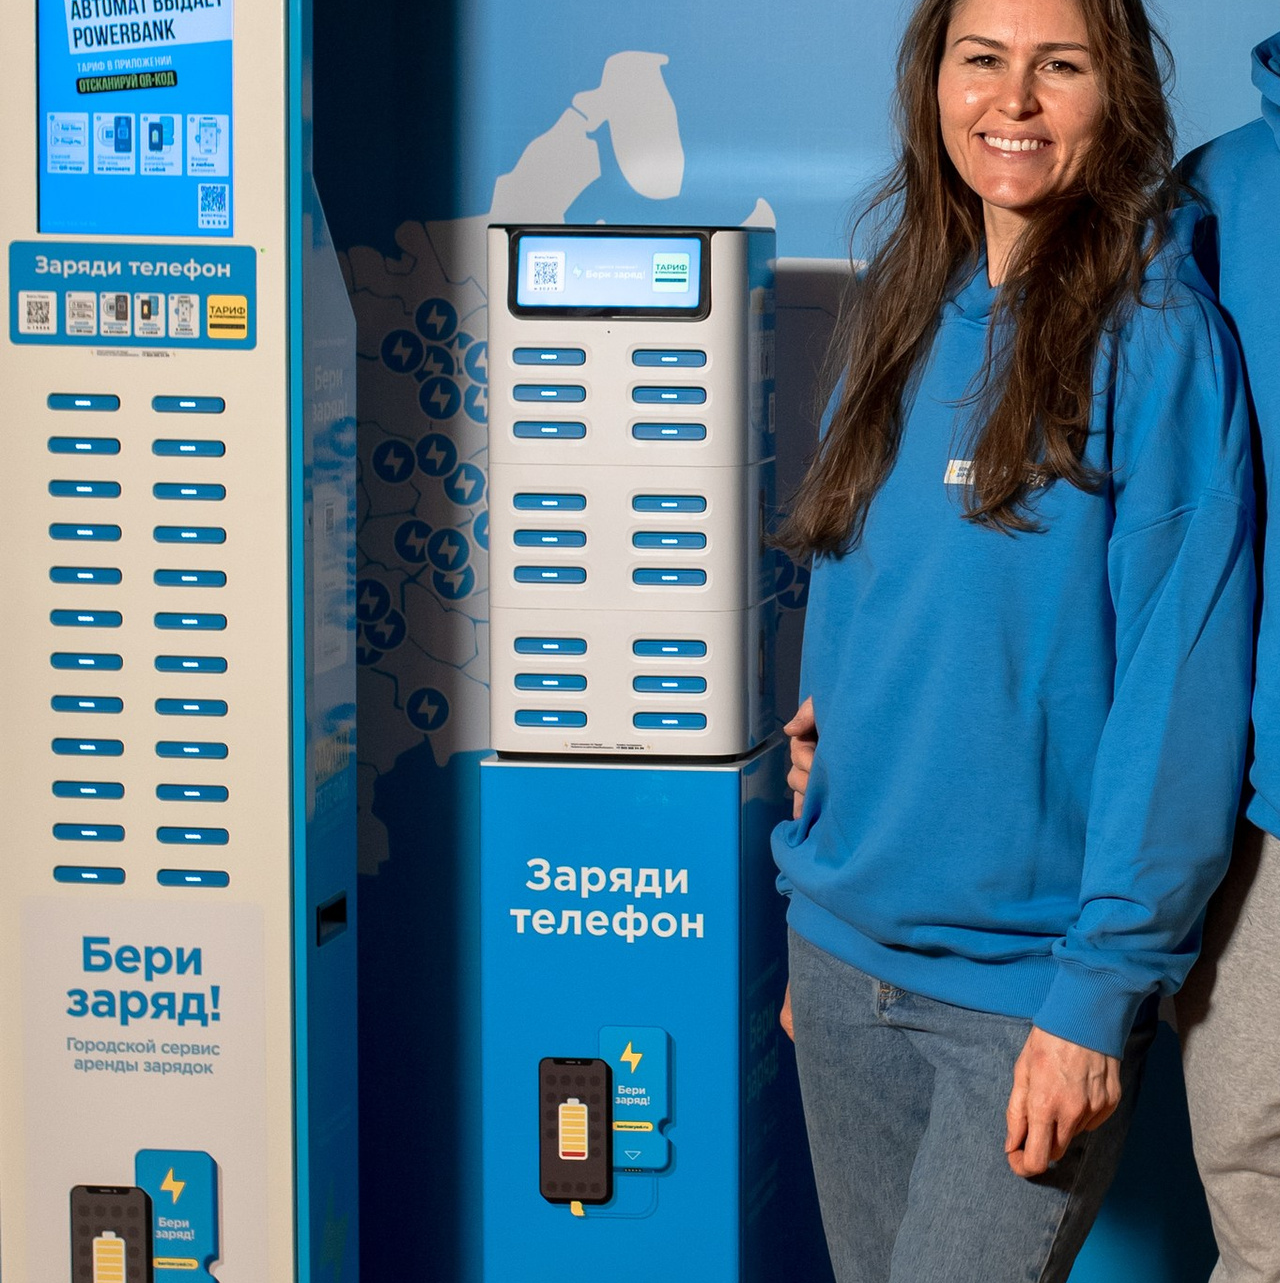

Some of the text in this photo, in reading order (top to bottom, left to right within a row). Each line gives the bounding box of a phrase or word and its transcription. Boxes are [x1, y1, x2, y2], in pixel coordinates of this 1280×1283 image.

[72, 18, 176, 49] POWERBANK
[76, 61, 106, 73] ТАРИФ
[114, 54, 173, 70] ПРИЛОЖЕНИИ
[78, 70, 176, 93] ОТСКАНИРУЙ QR-КОД
[35, 255, 231, 281] Заряди телефон
[655, 263, 688, 271] ТАРИФ
[209, 305, 246, 316] ТАРИФ
[525, 857, 689, 899] Заряди
[509, 903, 705, 944] телефон
[82, 935, 203, 982] Бери
[65, 984, 221, 1028] заряд!
[66, 1036, 221, 1058] Городской сервис
[73, 1058, 214, 1076] аренды зарядок
[614, 1095, 651, 1106] заряд!
[617, 1085, 646, 1096] Бери
[158, 1216, 190, 1229] Бери
[155, 1229, 195, 1241] заряд!
